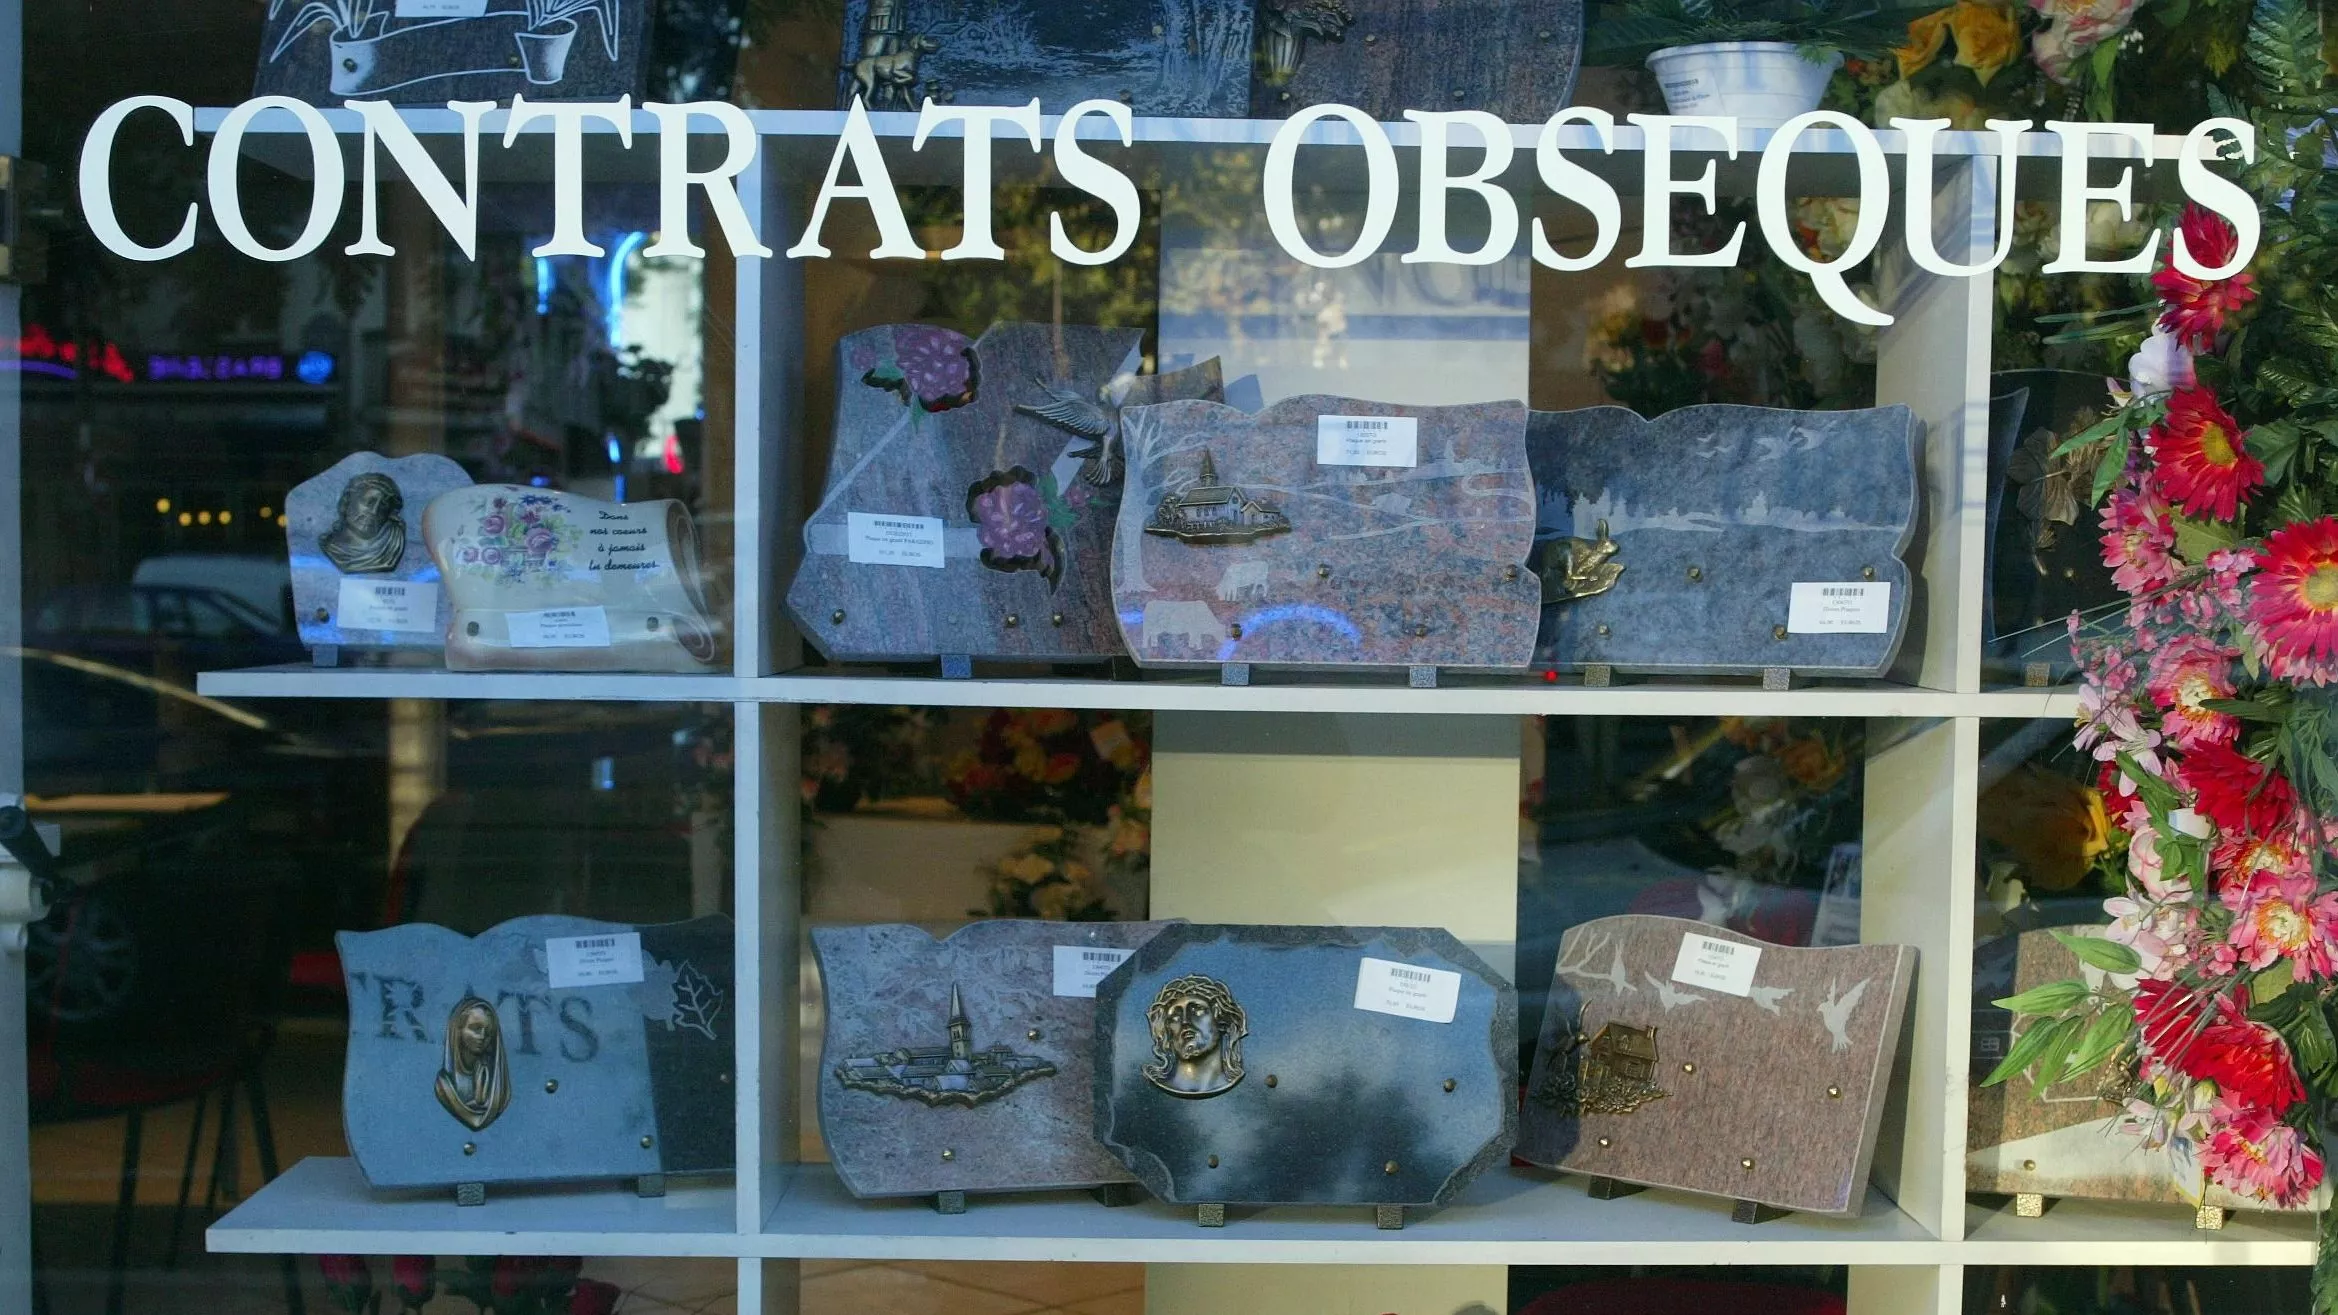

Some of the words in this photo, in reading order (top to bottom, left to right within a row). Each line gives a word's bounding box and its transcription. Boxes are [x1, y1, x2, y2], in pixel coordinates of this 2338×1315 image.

[78, 93, 1142, 269] CONTRATS
[1262, 102, 2264, 327] OBSEQUES
[598, 510, 629, 520] Dans
[589, 527, 608, 536] nos
[607, 543, 646, 556] jamais
[603, 558, 660, 571] demeures
